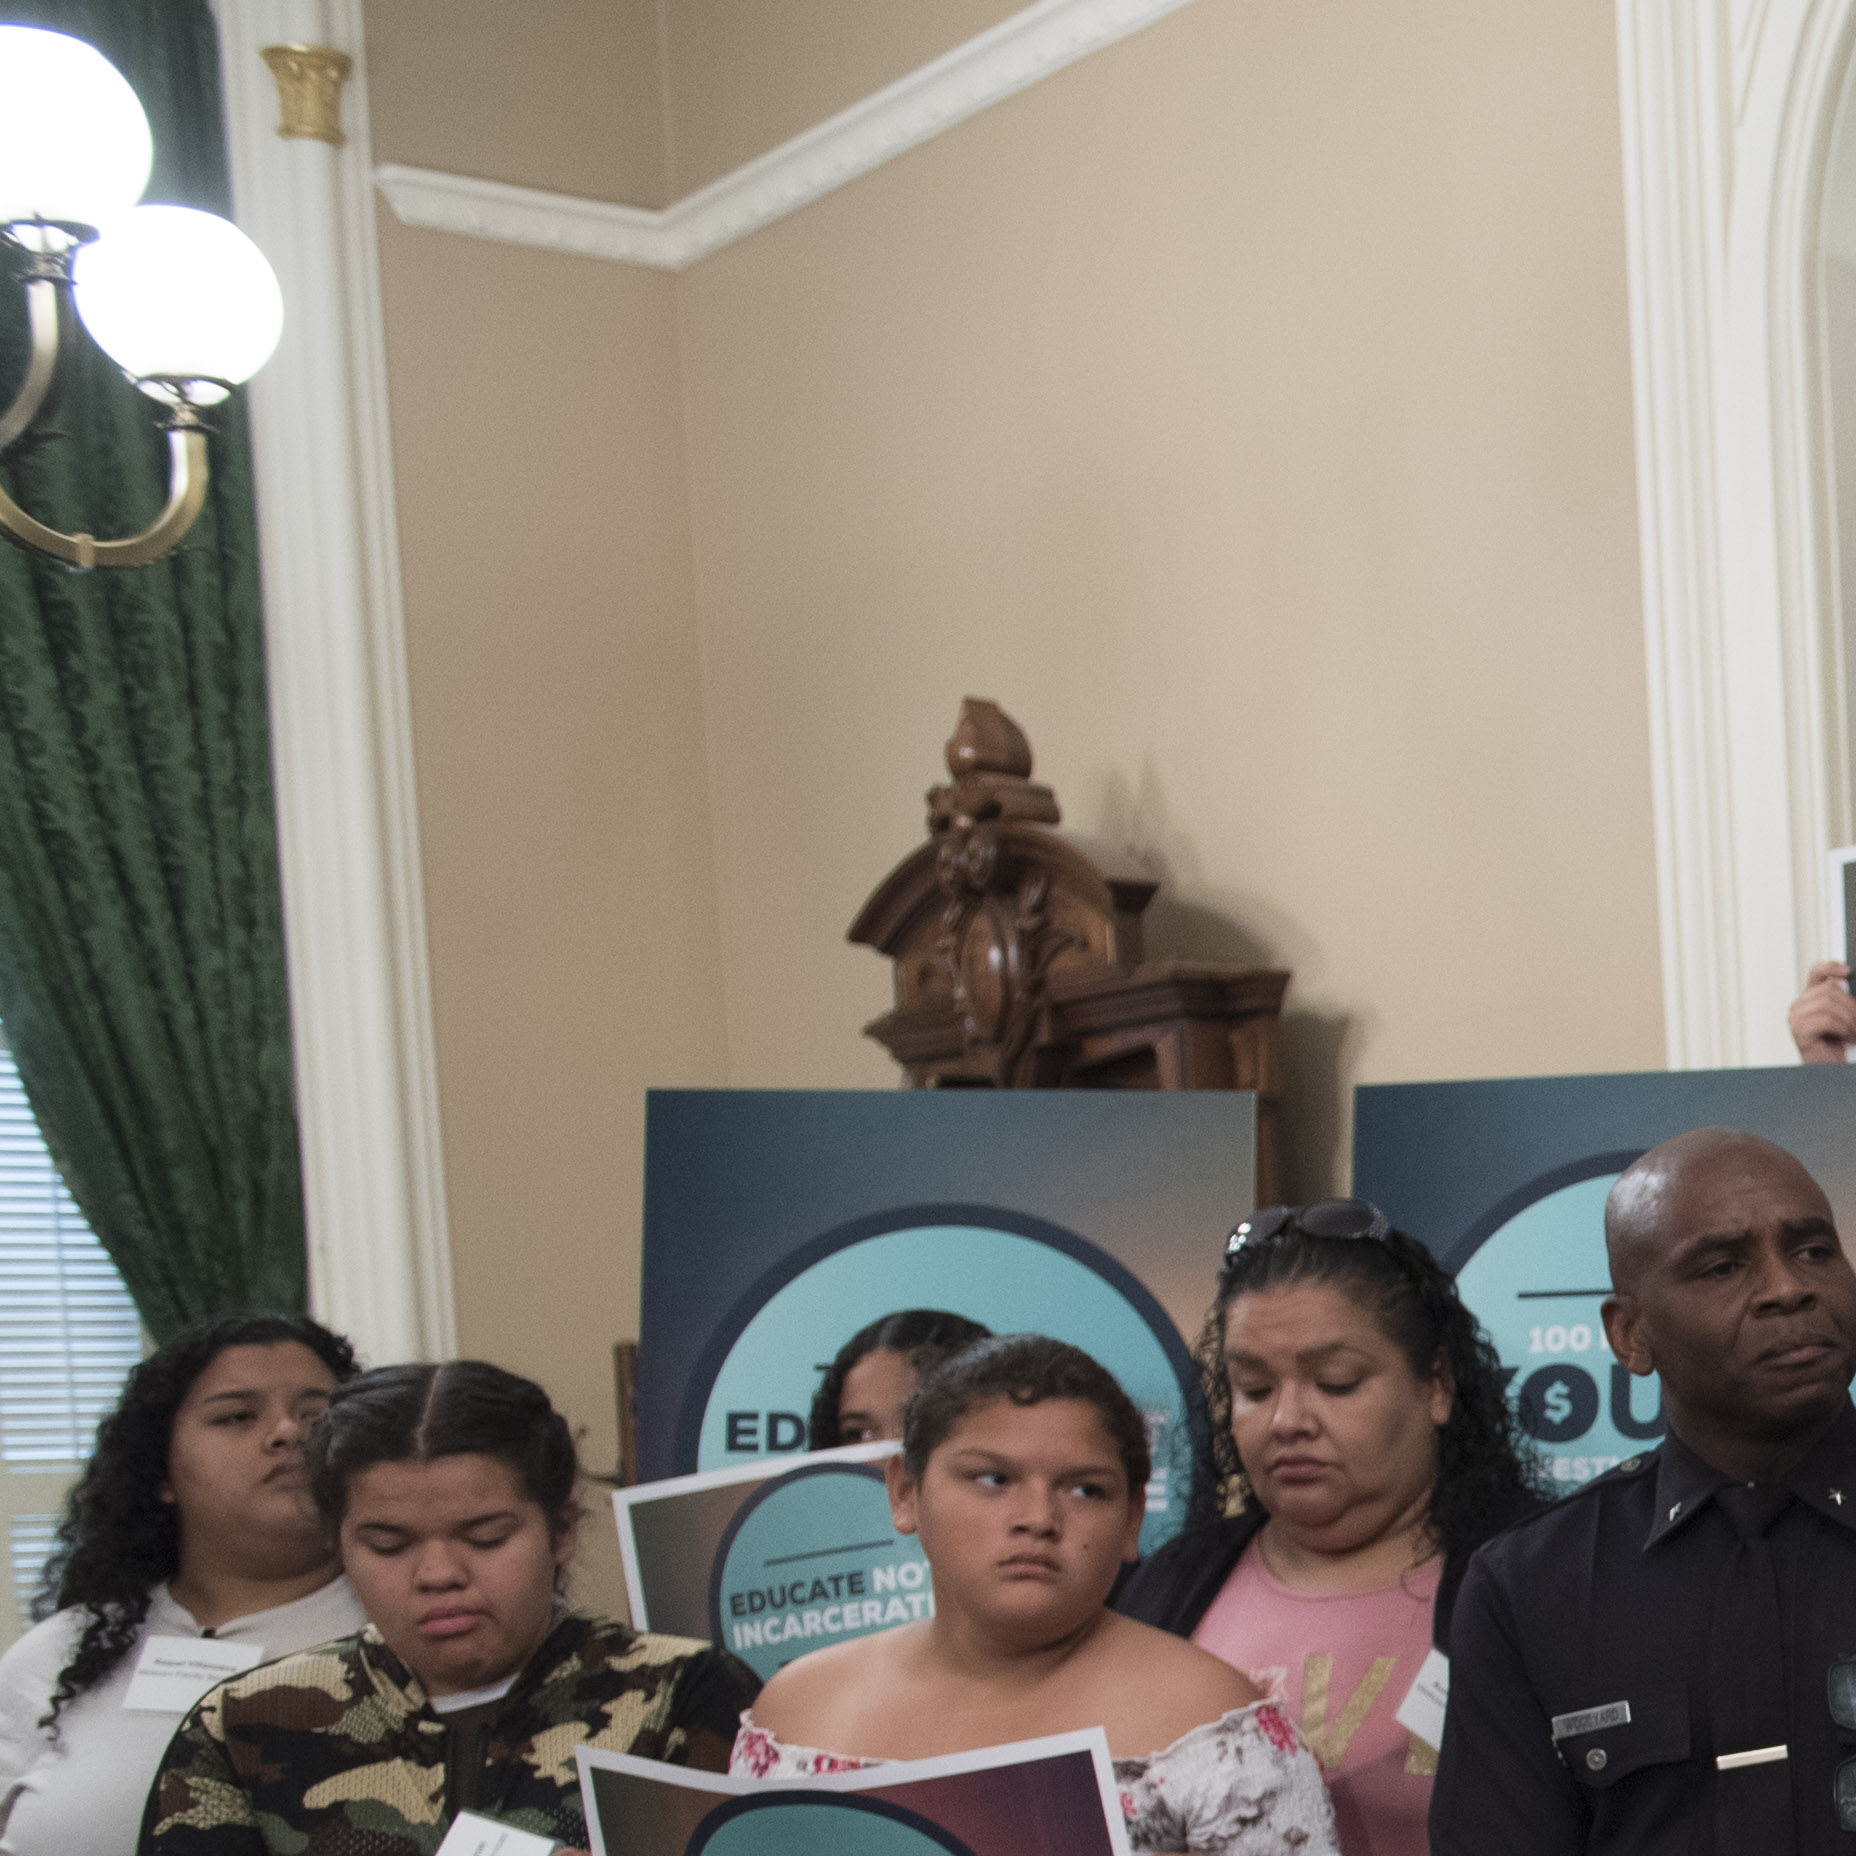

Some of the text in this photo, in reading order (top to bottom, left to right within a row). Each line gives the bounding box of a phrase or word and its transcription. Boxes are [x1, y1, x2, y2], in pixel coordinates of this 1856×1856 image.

[1529, 1324, 1592, 1353] 100
[729, 1560, 932, 1618] EDUCATE NO
